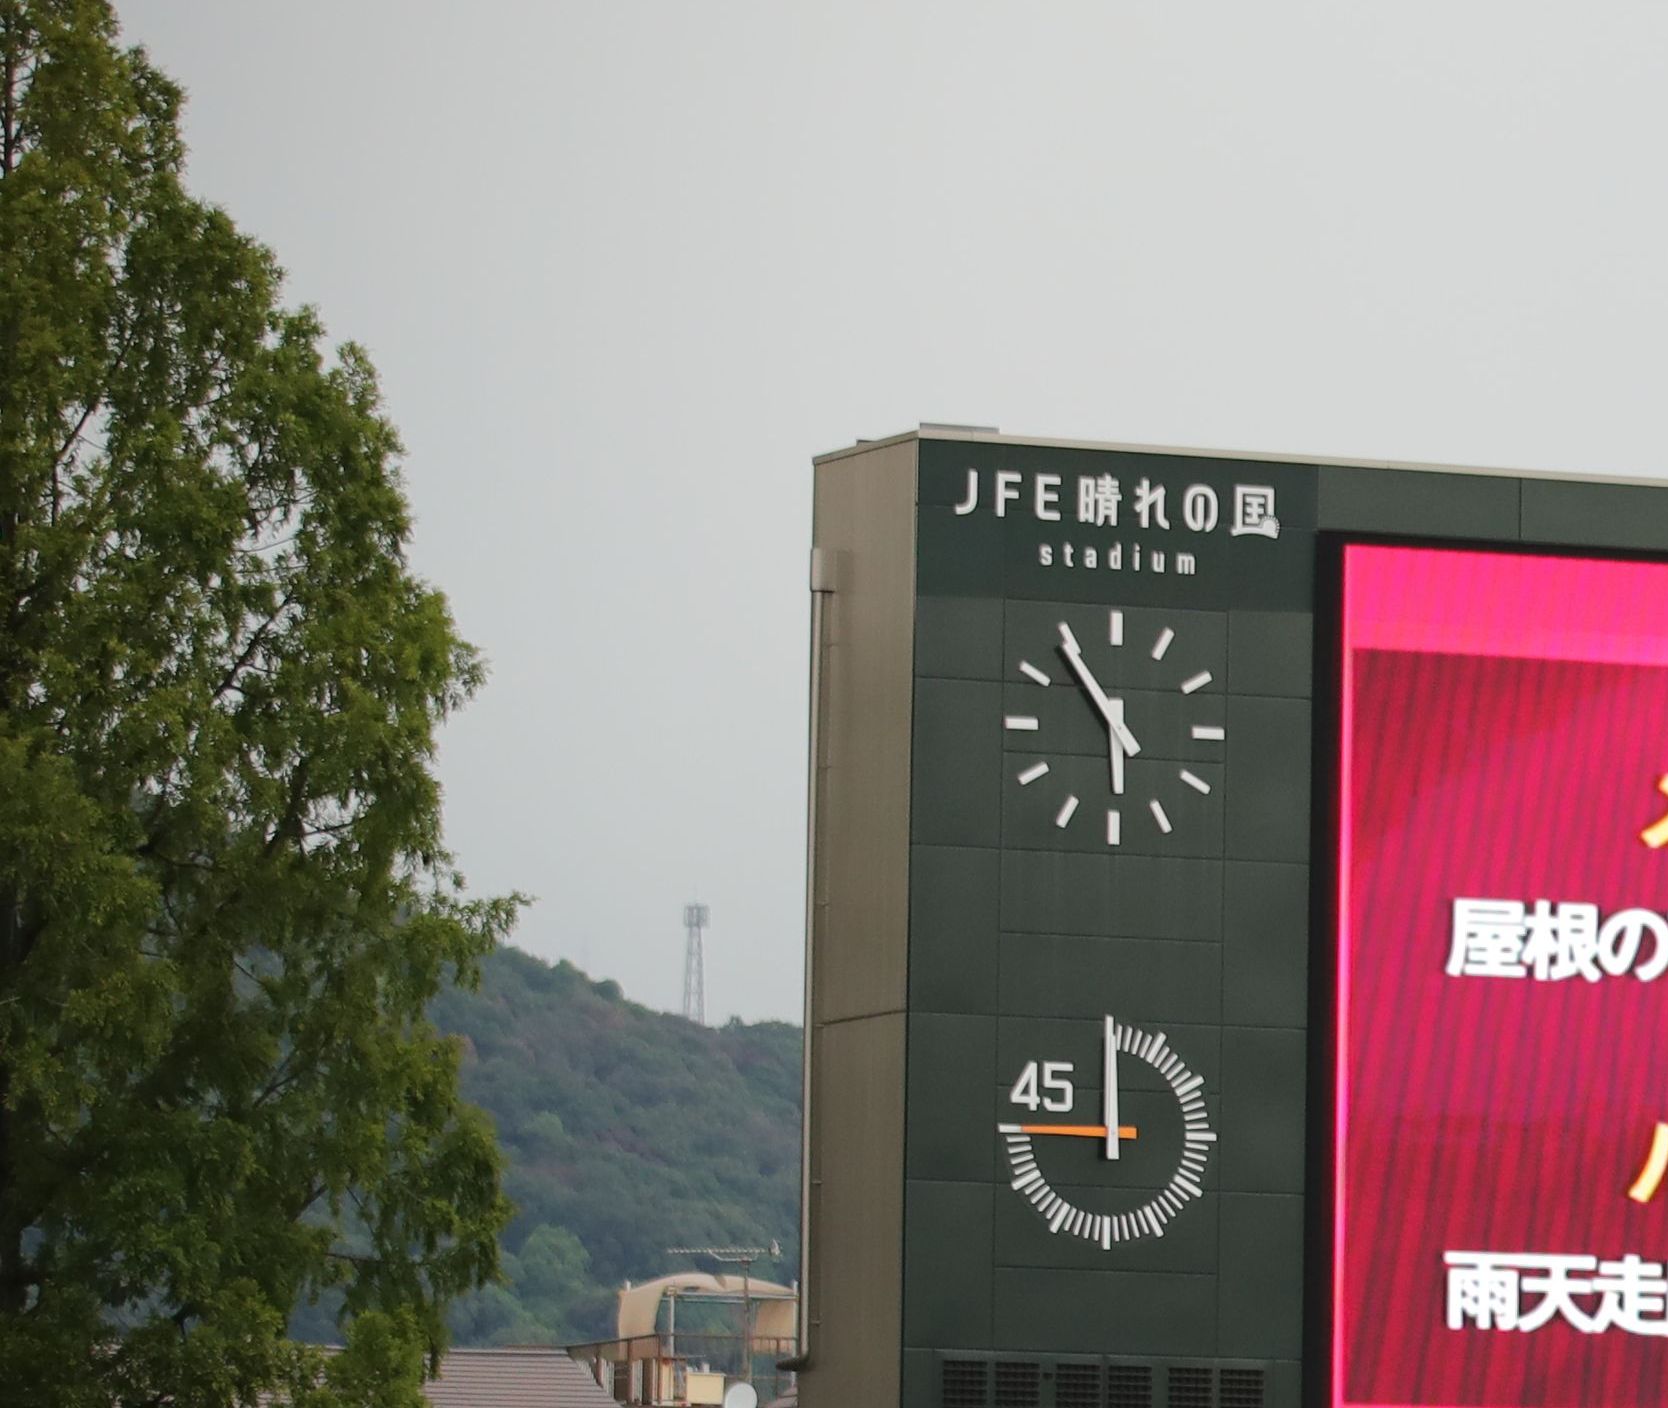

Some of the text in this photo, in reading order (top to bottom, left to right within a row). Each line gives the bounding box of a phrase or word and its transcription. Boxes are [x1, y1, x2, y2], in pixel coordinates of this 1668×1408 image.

[955, 467, 1281, 540] JFE晴れの国
[1039, 543, 1197, 576] stadium
[1009, 1060, 1074, 1113] 45
